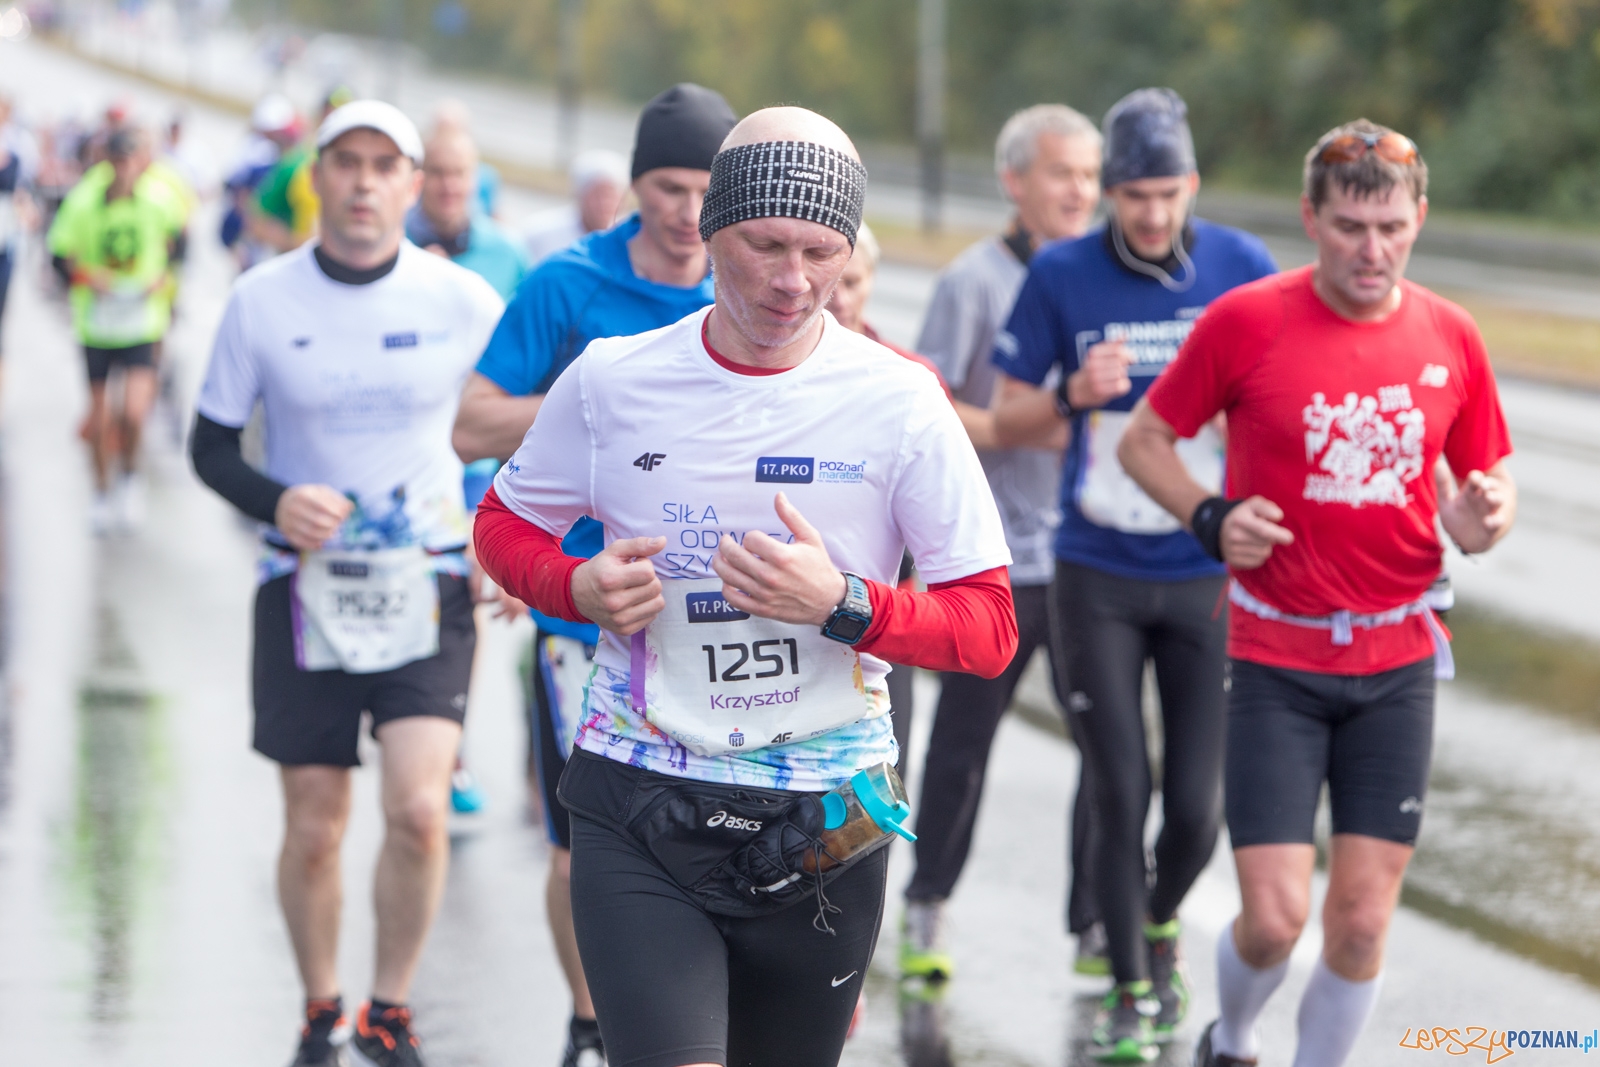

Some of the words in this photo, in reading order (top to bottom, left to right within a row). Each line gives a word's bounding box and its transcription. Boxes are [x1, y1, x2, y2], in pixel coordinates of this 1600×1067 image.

[633, 452, 667, 472] 4F
[818, 471, 863, 480] maraton
[662, 502, 719, 524] SIŁA
[701, 637, 800, 682] 1251
[710, 686, 801, 711] Krzysztof
[770, 731, 793, 744] 4F
[724, 815, 764, 832] asics
